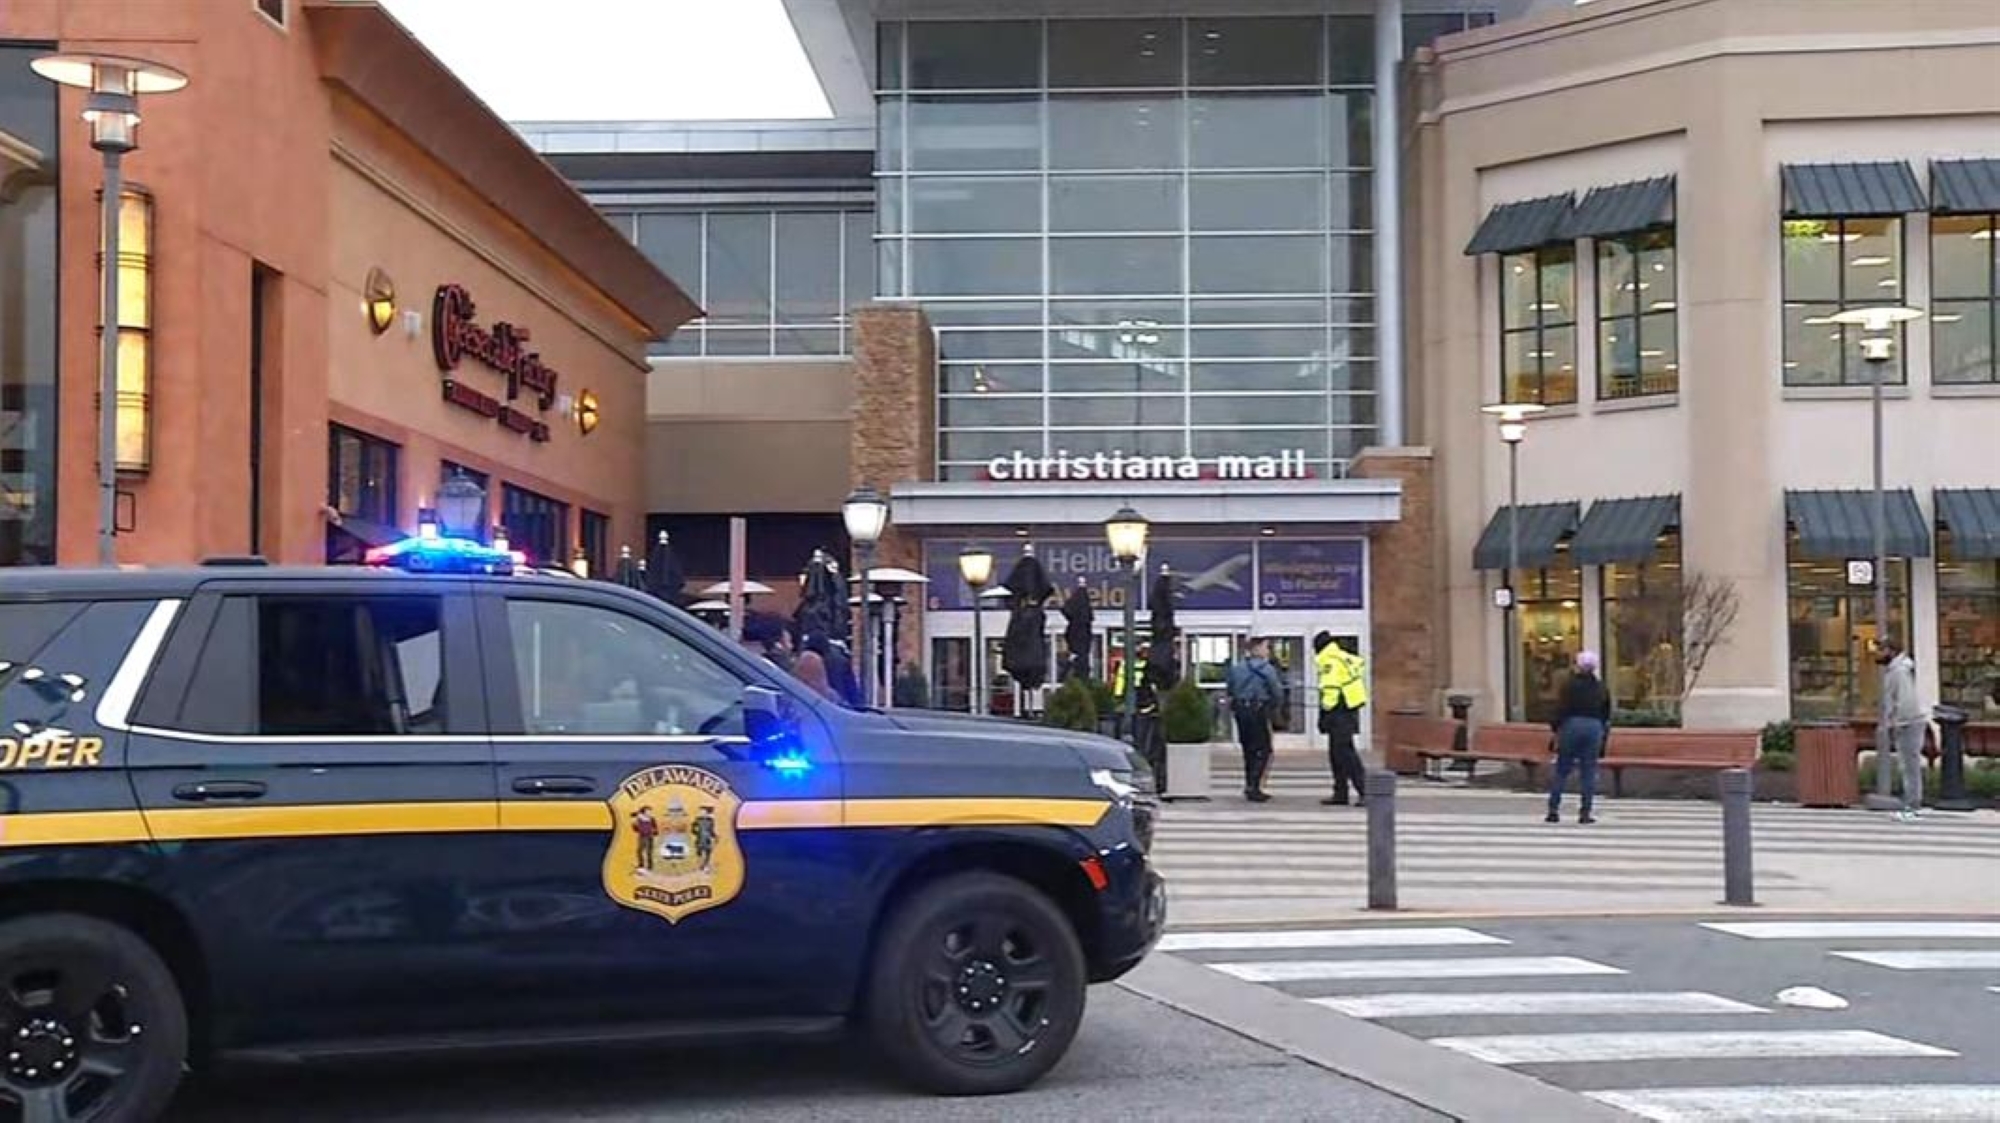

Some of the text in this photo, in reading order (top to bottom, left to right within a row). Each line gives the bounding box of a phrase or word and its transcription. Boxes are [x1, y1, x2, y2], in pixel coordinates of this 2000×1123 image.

[988, 448, 1306, 480] christiana mall
[1048, 545, 1121, 573] Hello
[0, 737, 103, 768] OPER
[624, 767, 725, 799] DELAWARE
